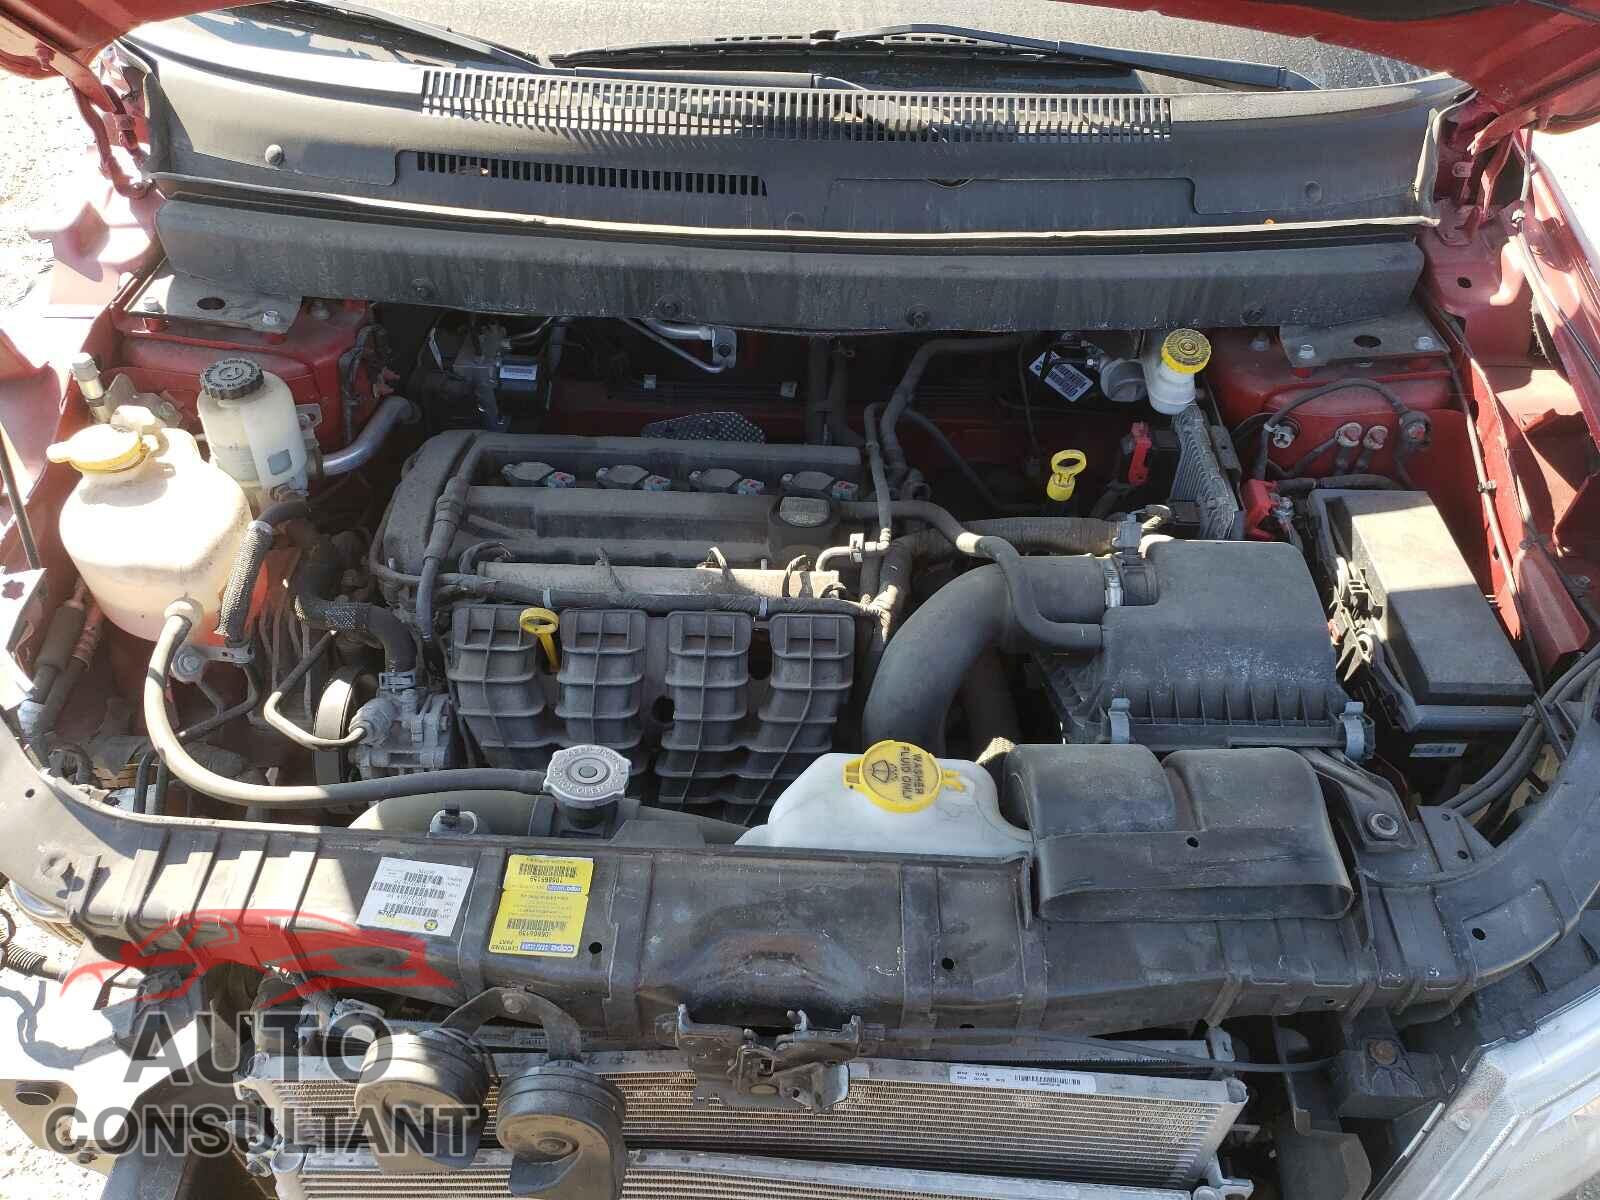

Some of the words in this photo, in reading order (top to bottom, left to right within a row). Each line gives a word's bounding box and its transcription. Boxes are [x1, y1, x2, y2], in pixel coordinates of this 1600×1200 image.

[900, 745, 911, 773] FLUID
[901, 775, 913, 799] ONLY
[911, 753, 924, 794] WASHER
